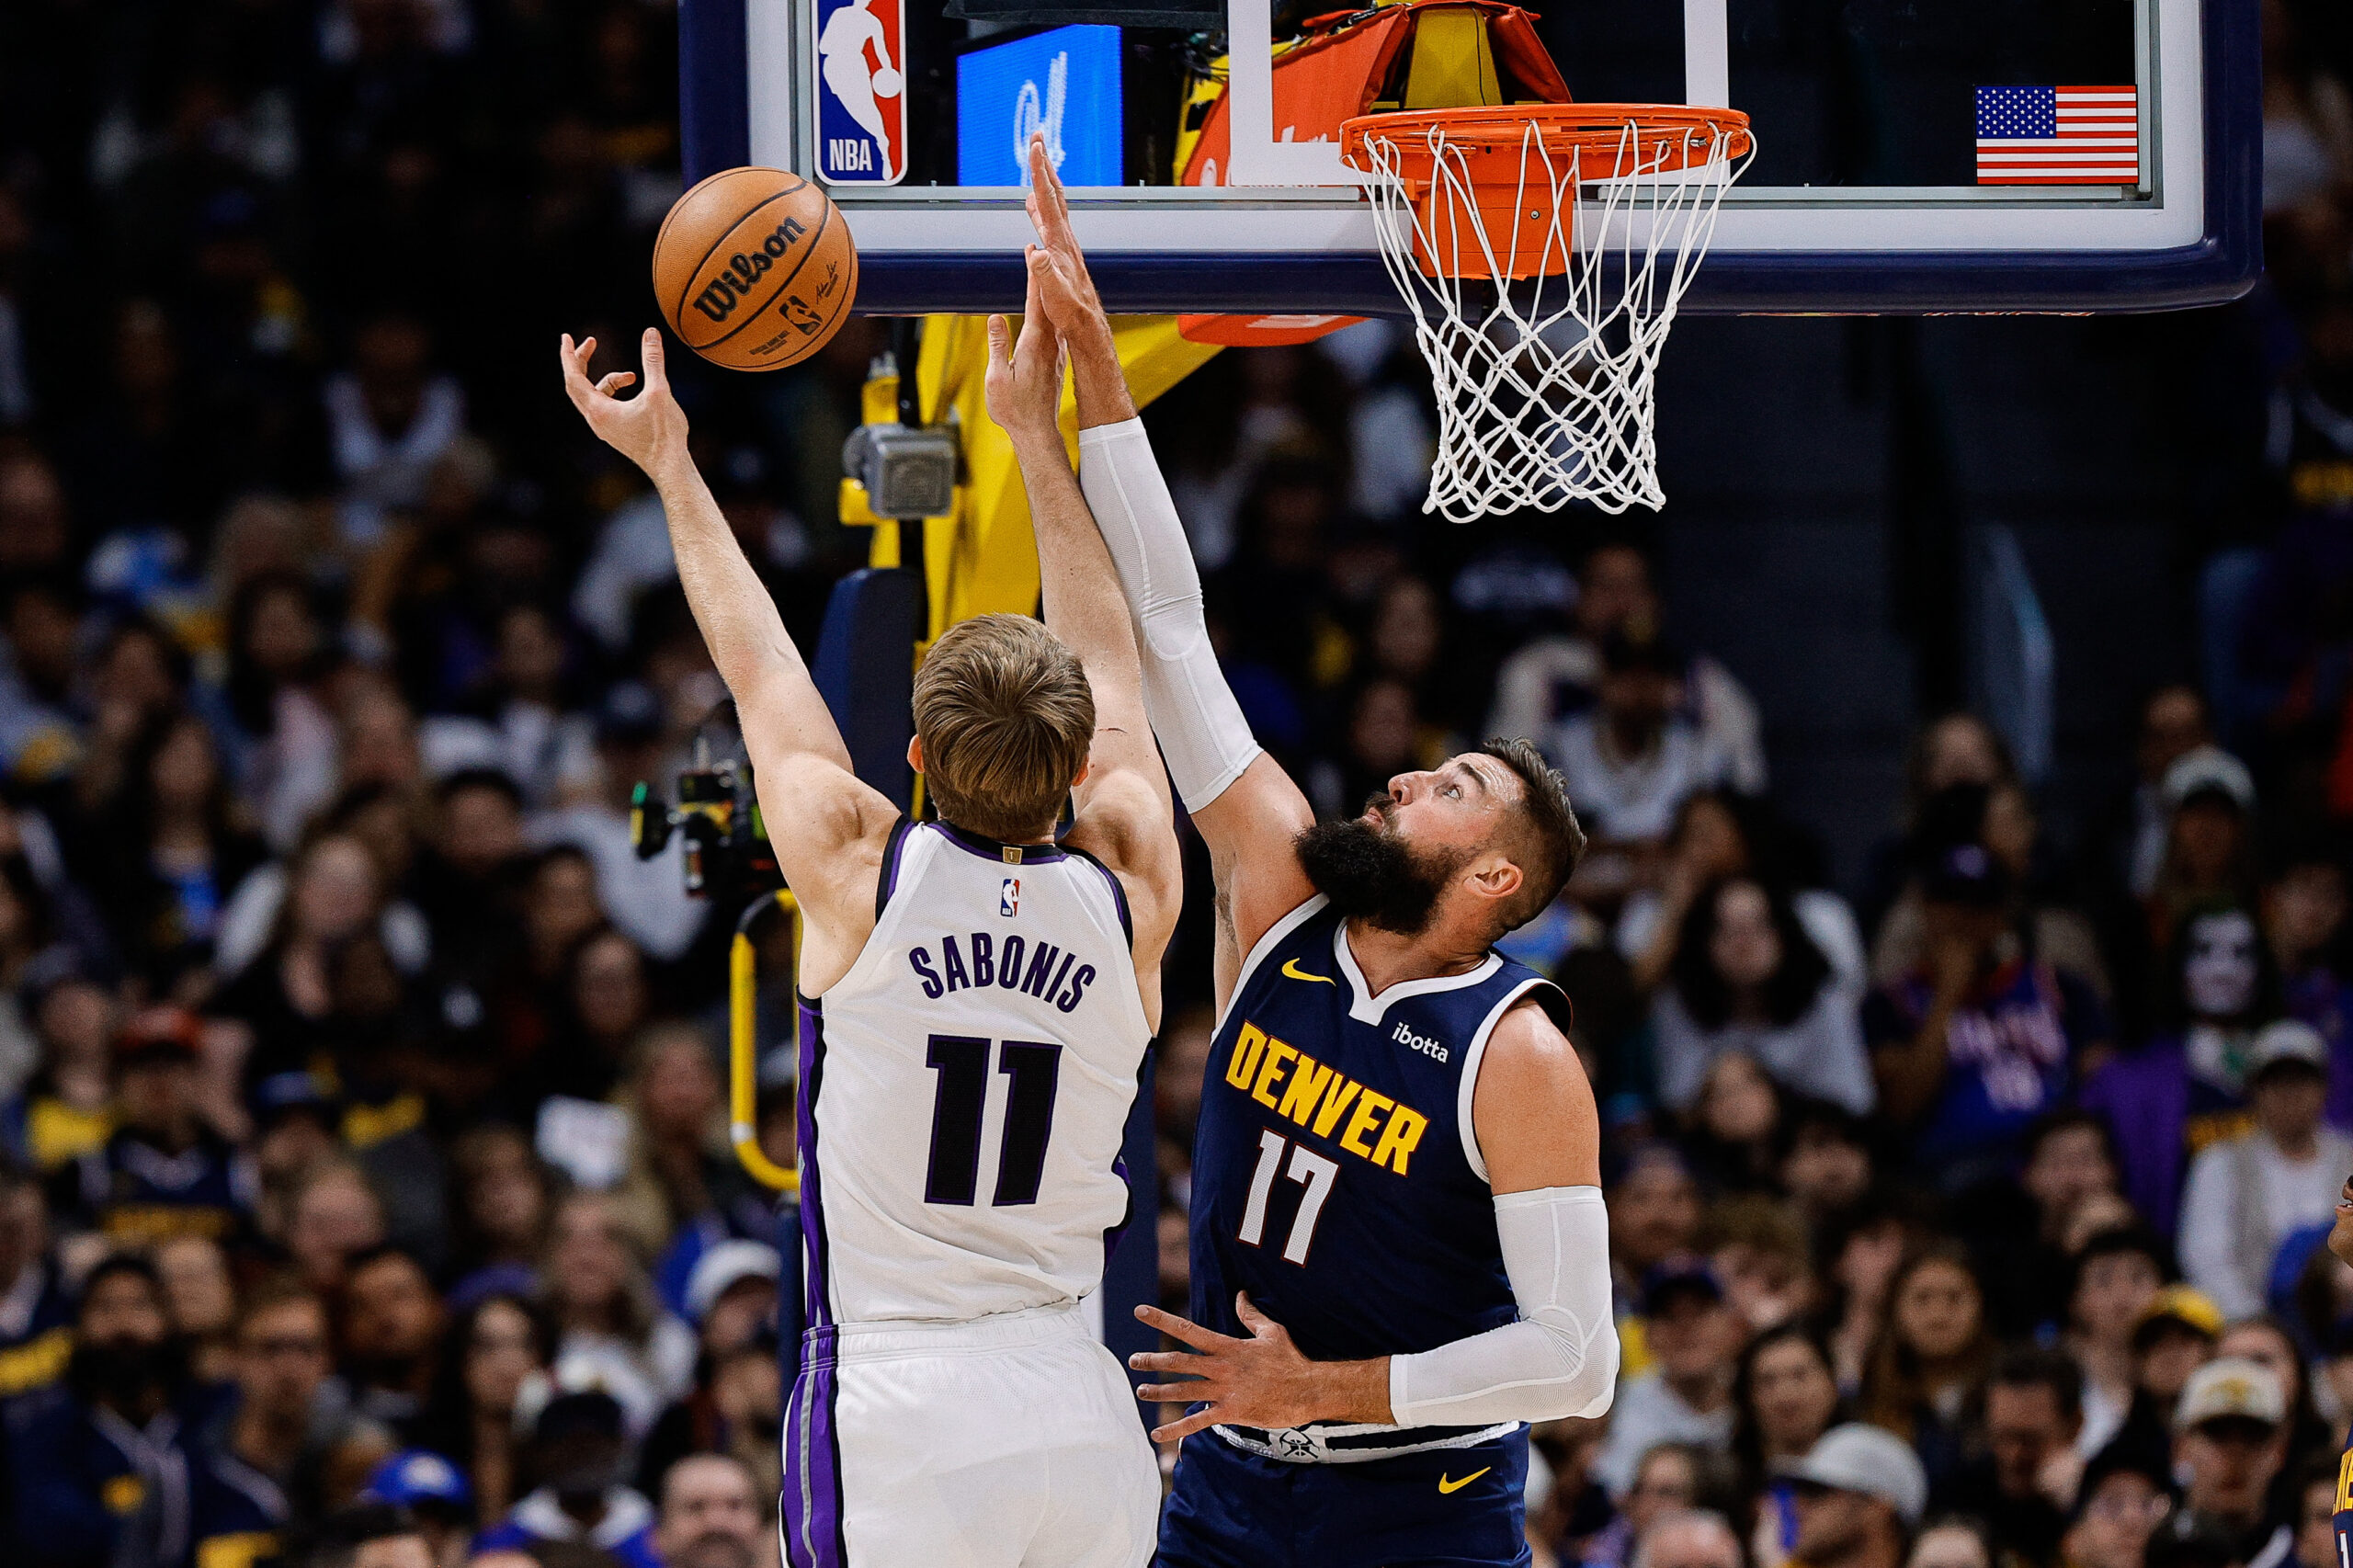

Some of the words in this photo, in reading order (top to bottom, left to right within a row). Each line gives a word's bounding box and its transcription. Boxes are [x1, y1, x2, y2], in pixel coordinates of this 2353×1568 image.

[829, 139, 872, 172] NBA
[692, 215, 808, 323] Wilson
[908, 932, 1097, 1014] SABONIS
[1392, 1022, 1449, 1064] ibotta
[924, 1033, 1063, 1207] 11
[1224, 1018, 1430, 1178] DENVER
[1236, 1126, 1341, 1268] 17
